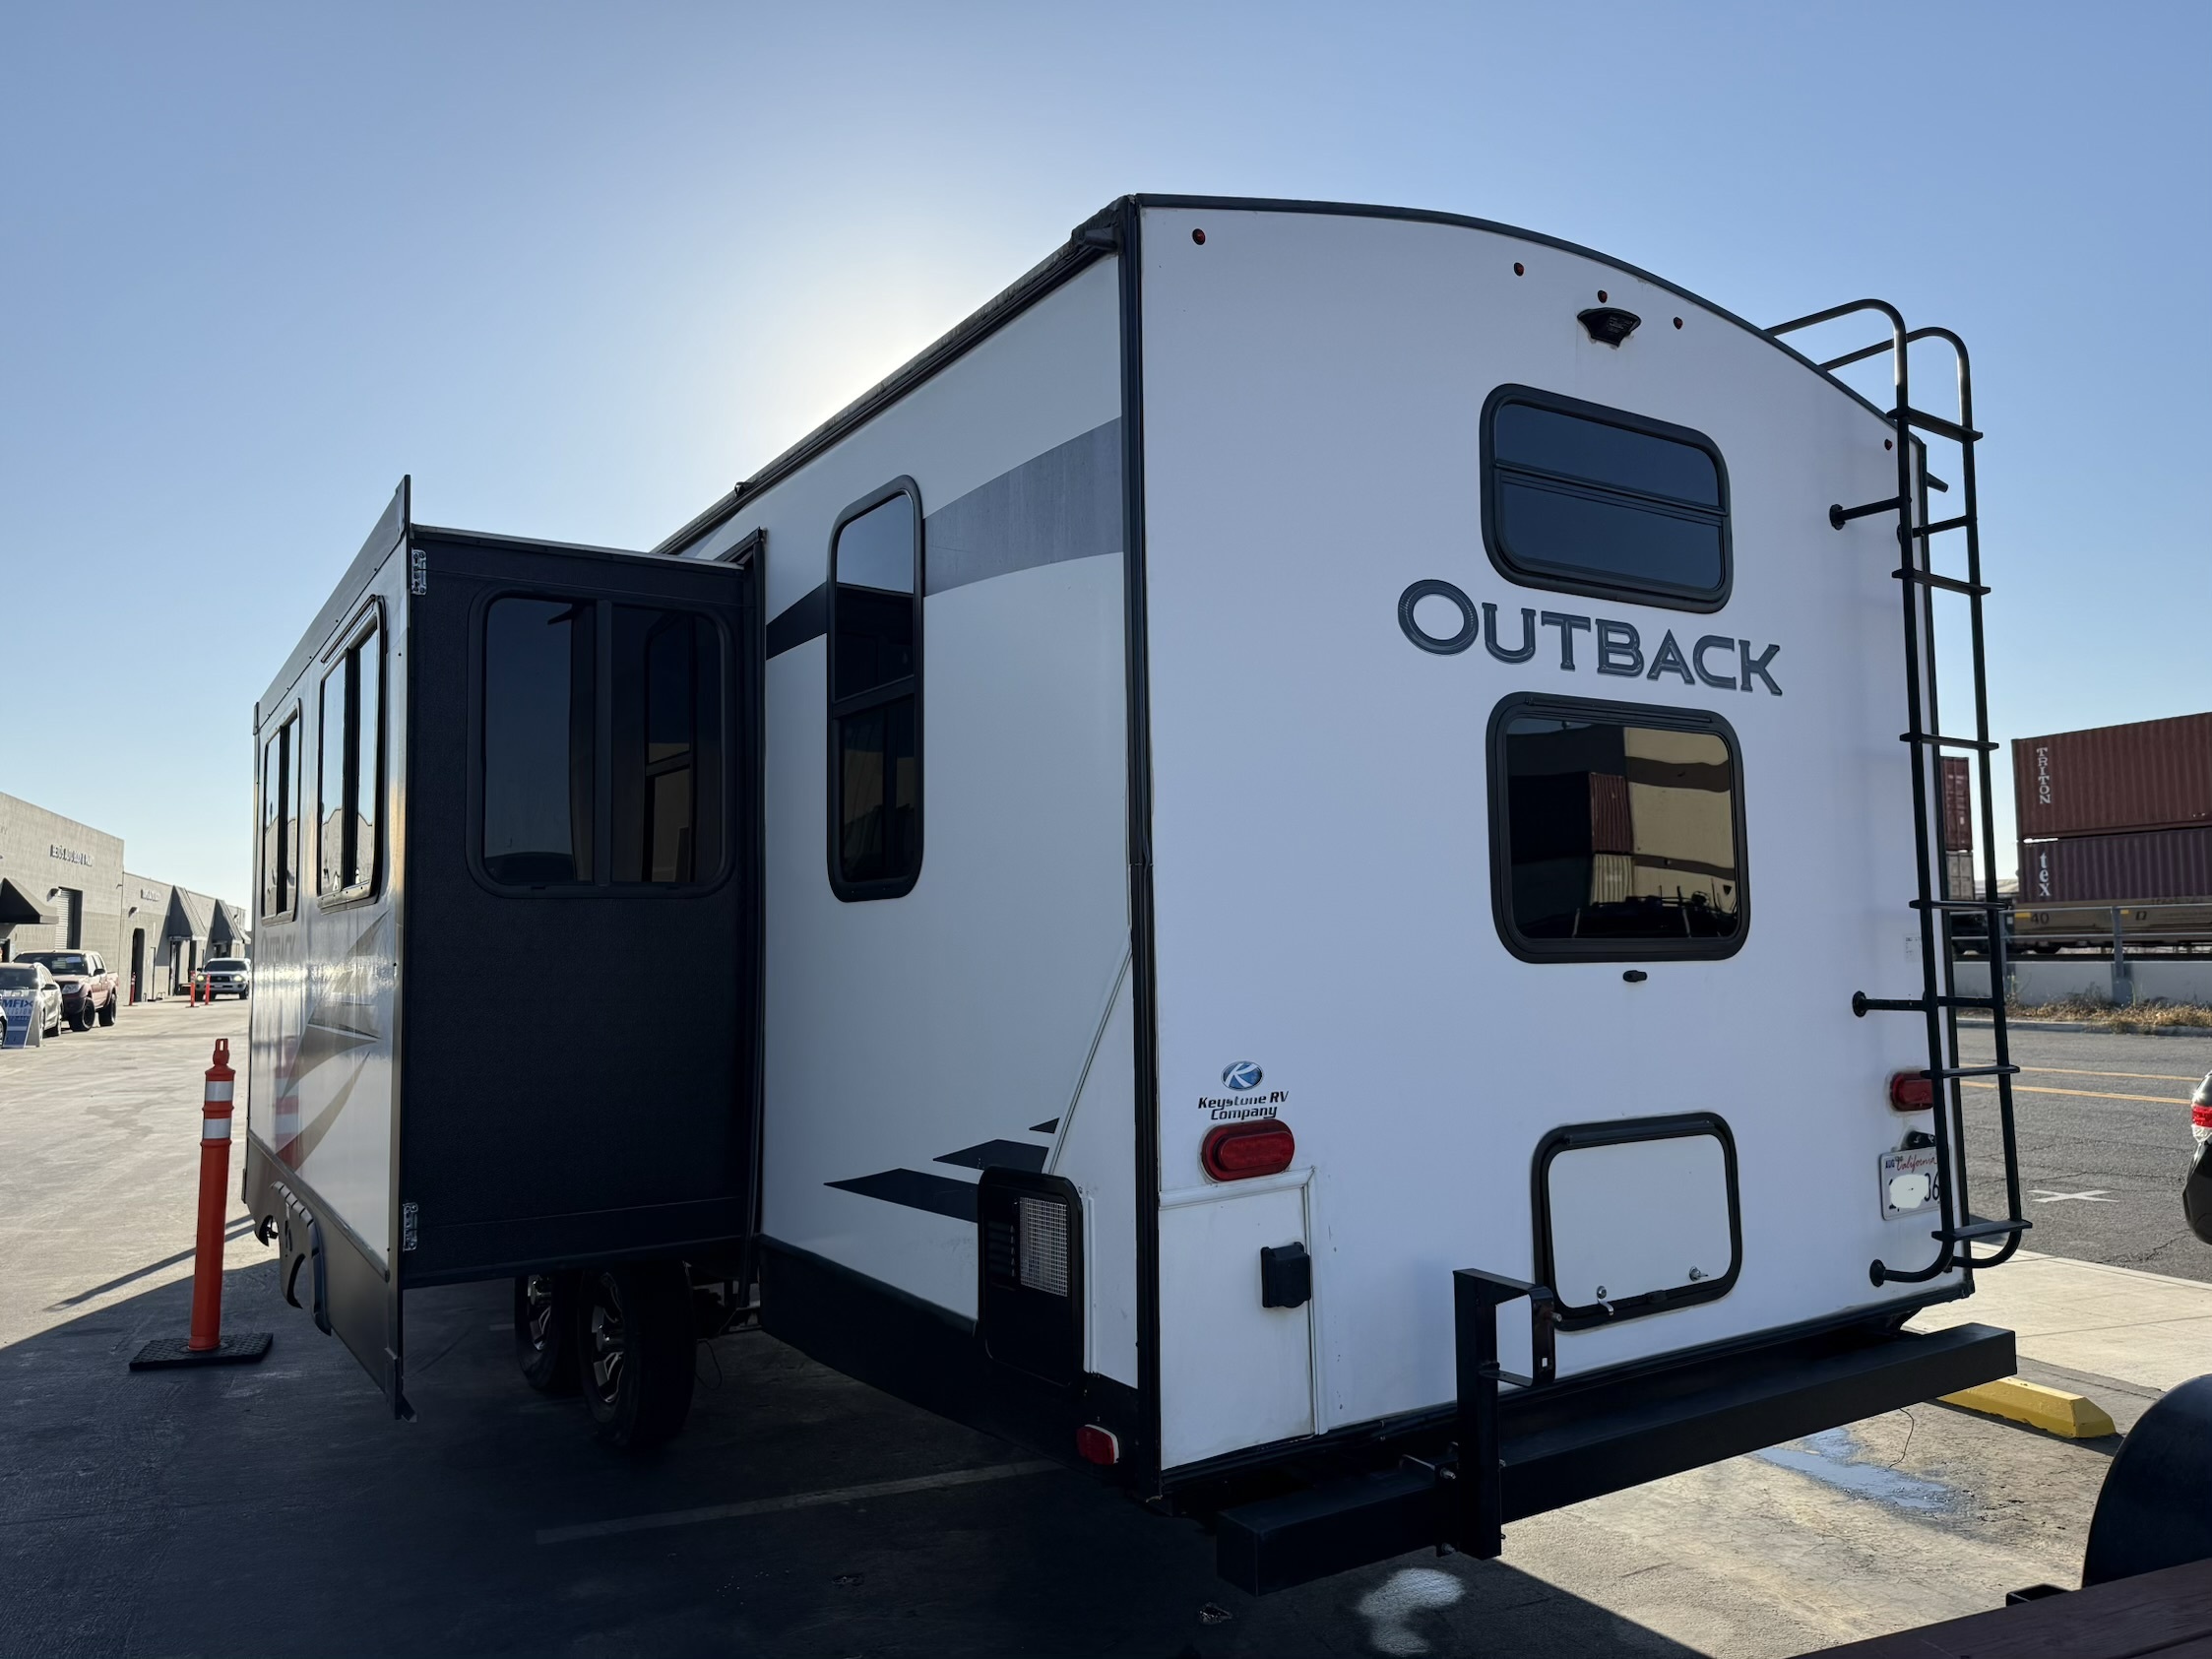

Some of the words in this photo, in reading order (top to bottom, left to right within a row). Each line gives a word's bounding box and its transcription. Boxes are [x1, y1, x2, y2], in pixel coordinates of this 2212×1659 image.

[1397, 579, 1783, 697] OUTBACK
[2037, 747, 2051, 804] TRITON
[2040, 853, 2051, 896] tex
[2030, 912, 2050, 925] 40
[1198, 1096, 1266, 1110] Keystone
[1270, 1091, 1289, 1104] RV
[1212, 1107, 1278, 1119] Company
[1896, 1154, 1937, 1173] California
